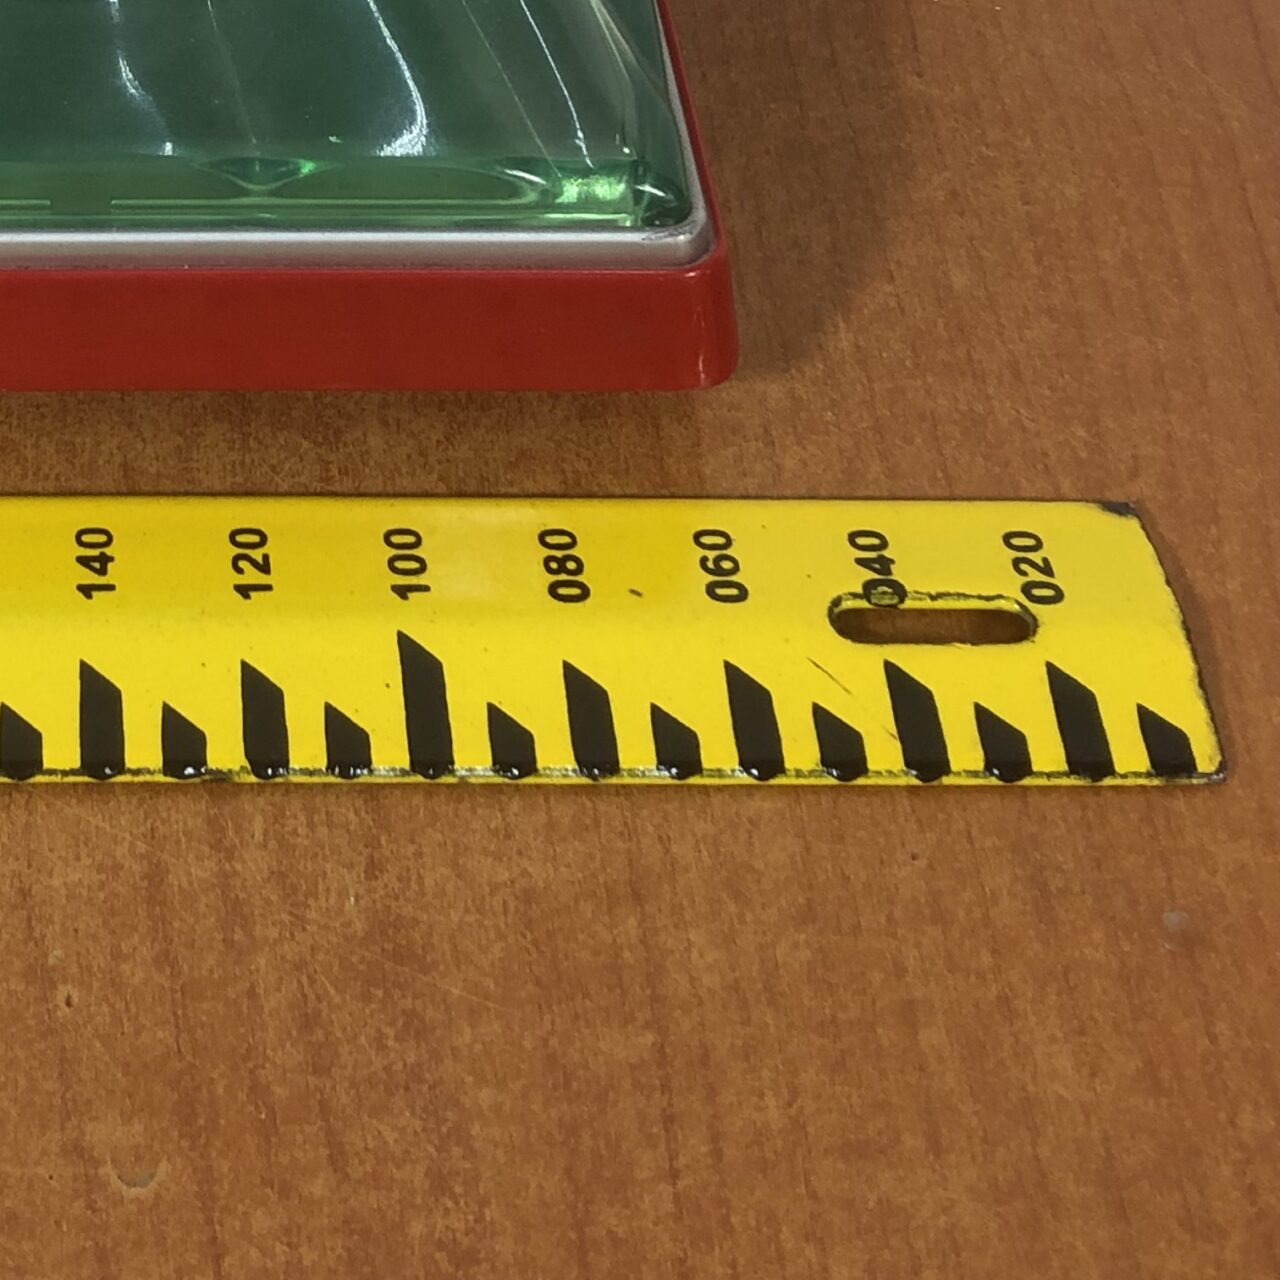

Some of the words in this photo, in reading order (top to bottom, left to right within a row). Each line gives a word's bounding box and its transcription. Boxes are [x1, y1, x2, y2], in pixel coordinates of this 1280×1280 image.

[74, 526, 117, 600] 140
[228, 526, 274, 601] 120
[382, 526, 432, 601] 100
[537, 527, 592, 603] 080
[692, 527, 749, 604] 060
[847, 528, 907, 608] 040
[1002, 530, 1065, 606] 020
